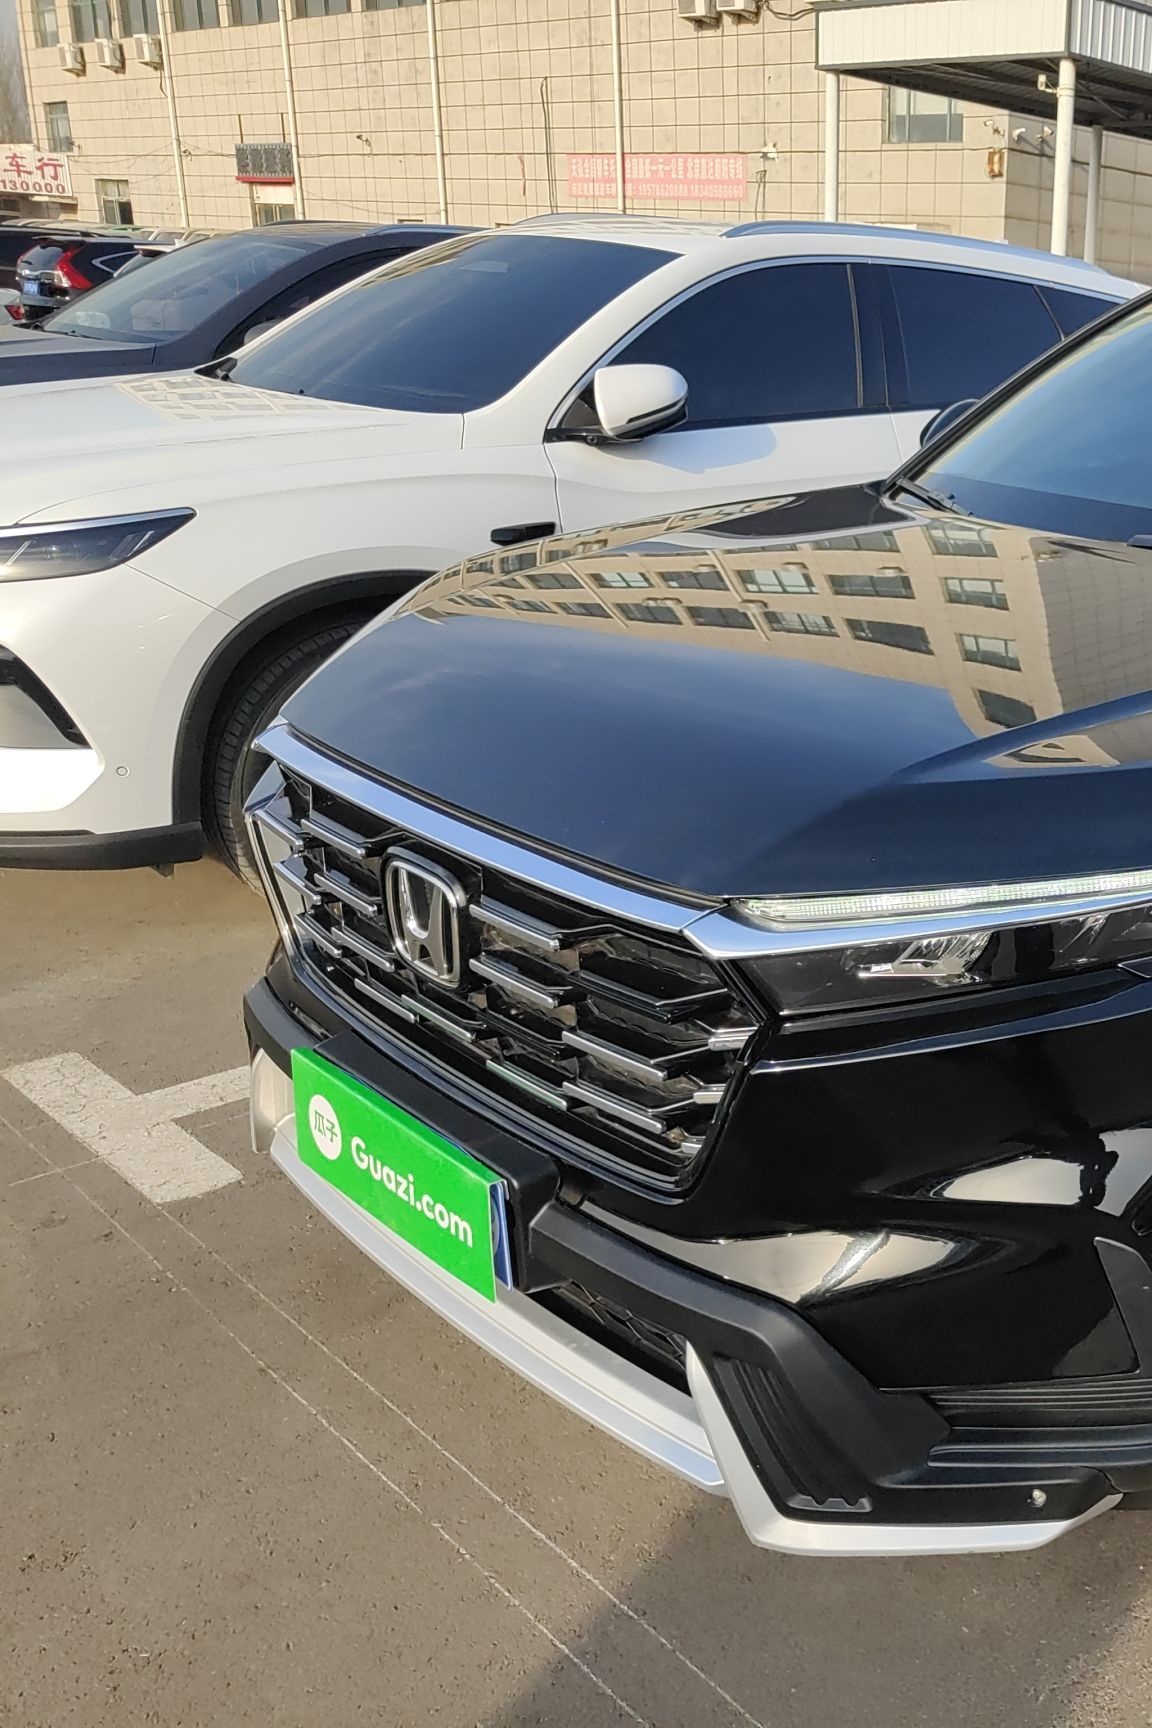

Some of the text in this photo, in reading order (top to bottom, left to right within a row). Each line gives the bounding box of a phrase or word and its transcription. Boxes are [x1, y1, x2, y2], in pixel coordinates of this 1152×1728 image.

[3, 152, 65, 181] 车行
[314, 1109, 339, 1144] 瓜子
[351, 1136, 474, 1248] Guazi.com
